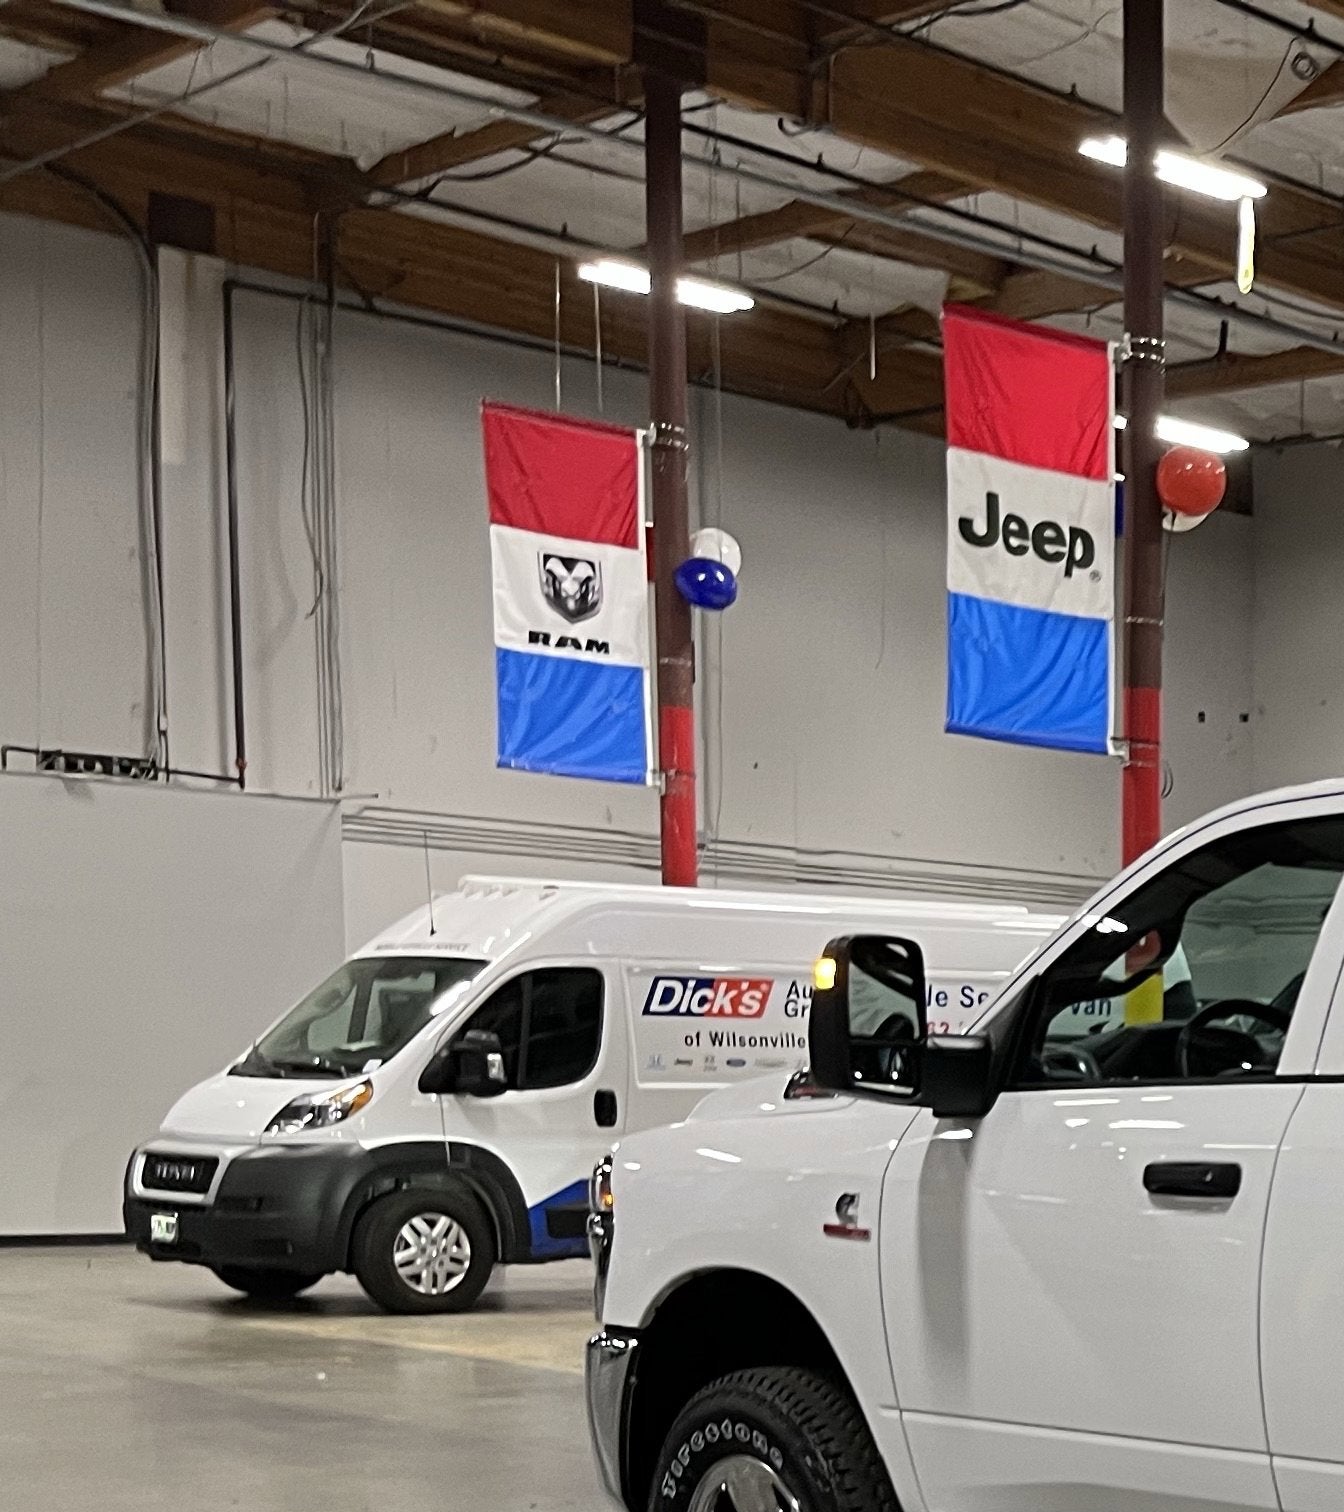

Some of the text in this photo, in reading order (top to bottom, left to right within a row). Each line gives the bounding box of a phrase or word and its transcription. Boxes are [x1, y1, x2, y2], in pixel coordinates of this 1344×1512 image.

[958, 491, 1095, 578] Jeep
[528, 630, 610, 655] RAM
[650, 979, 763, 1016] Dick's
[786, 979, 813, 999] Au
[684, 1031, 806, 1048] of Wilsonville
